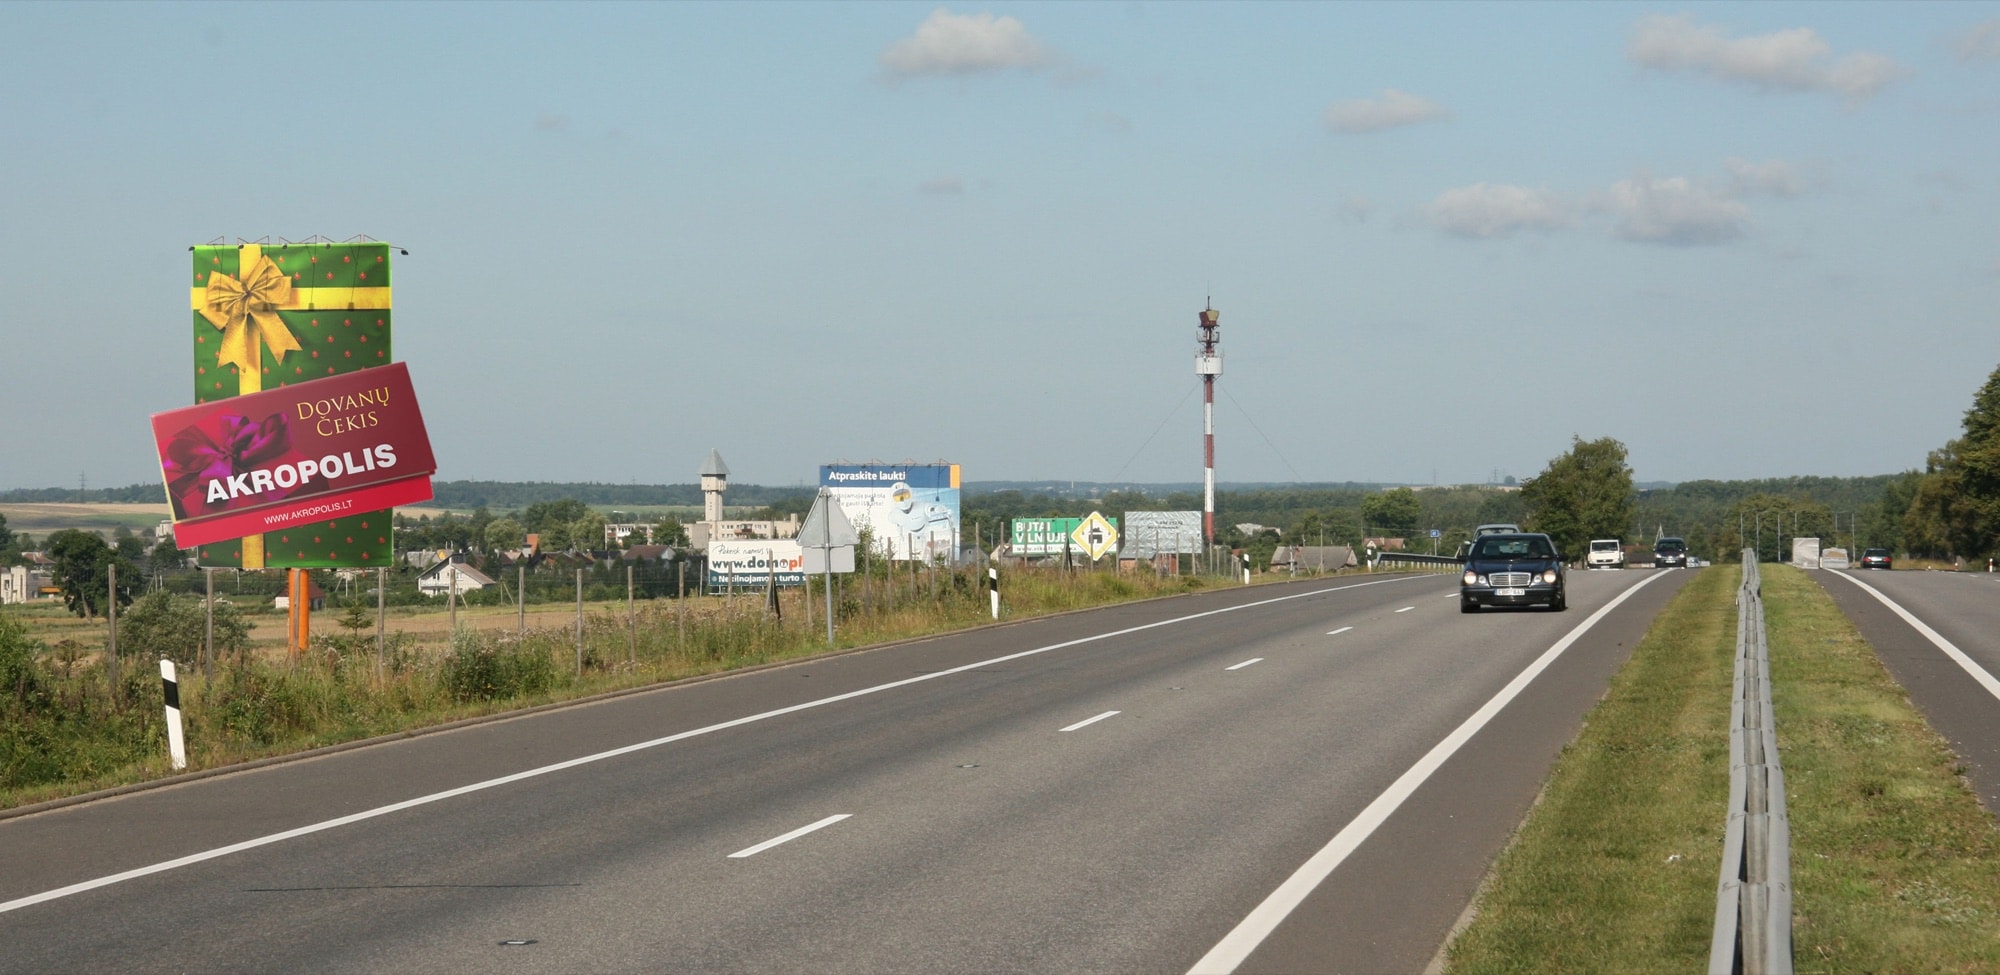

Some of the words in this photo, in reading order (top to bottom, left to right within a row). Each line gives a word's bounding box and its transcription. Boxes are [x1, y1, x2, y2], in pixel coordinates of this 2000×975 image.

[206, 443, 397, 504] AKROPOLIS
[828, 470, 878, 482] Atpraskite
[879, 470, 906, 481] laukti
[264, 499, 353, 526] WWW.AKROPOLIS.LT
[1015, 521, 1051, 532] BUTAI
[1015, 532, 1068, 543] VLNUJE
